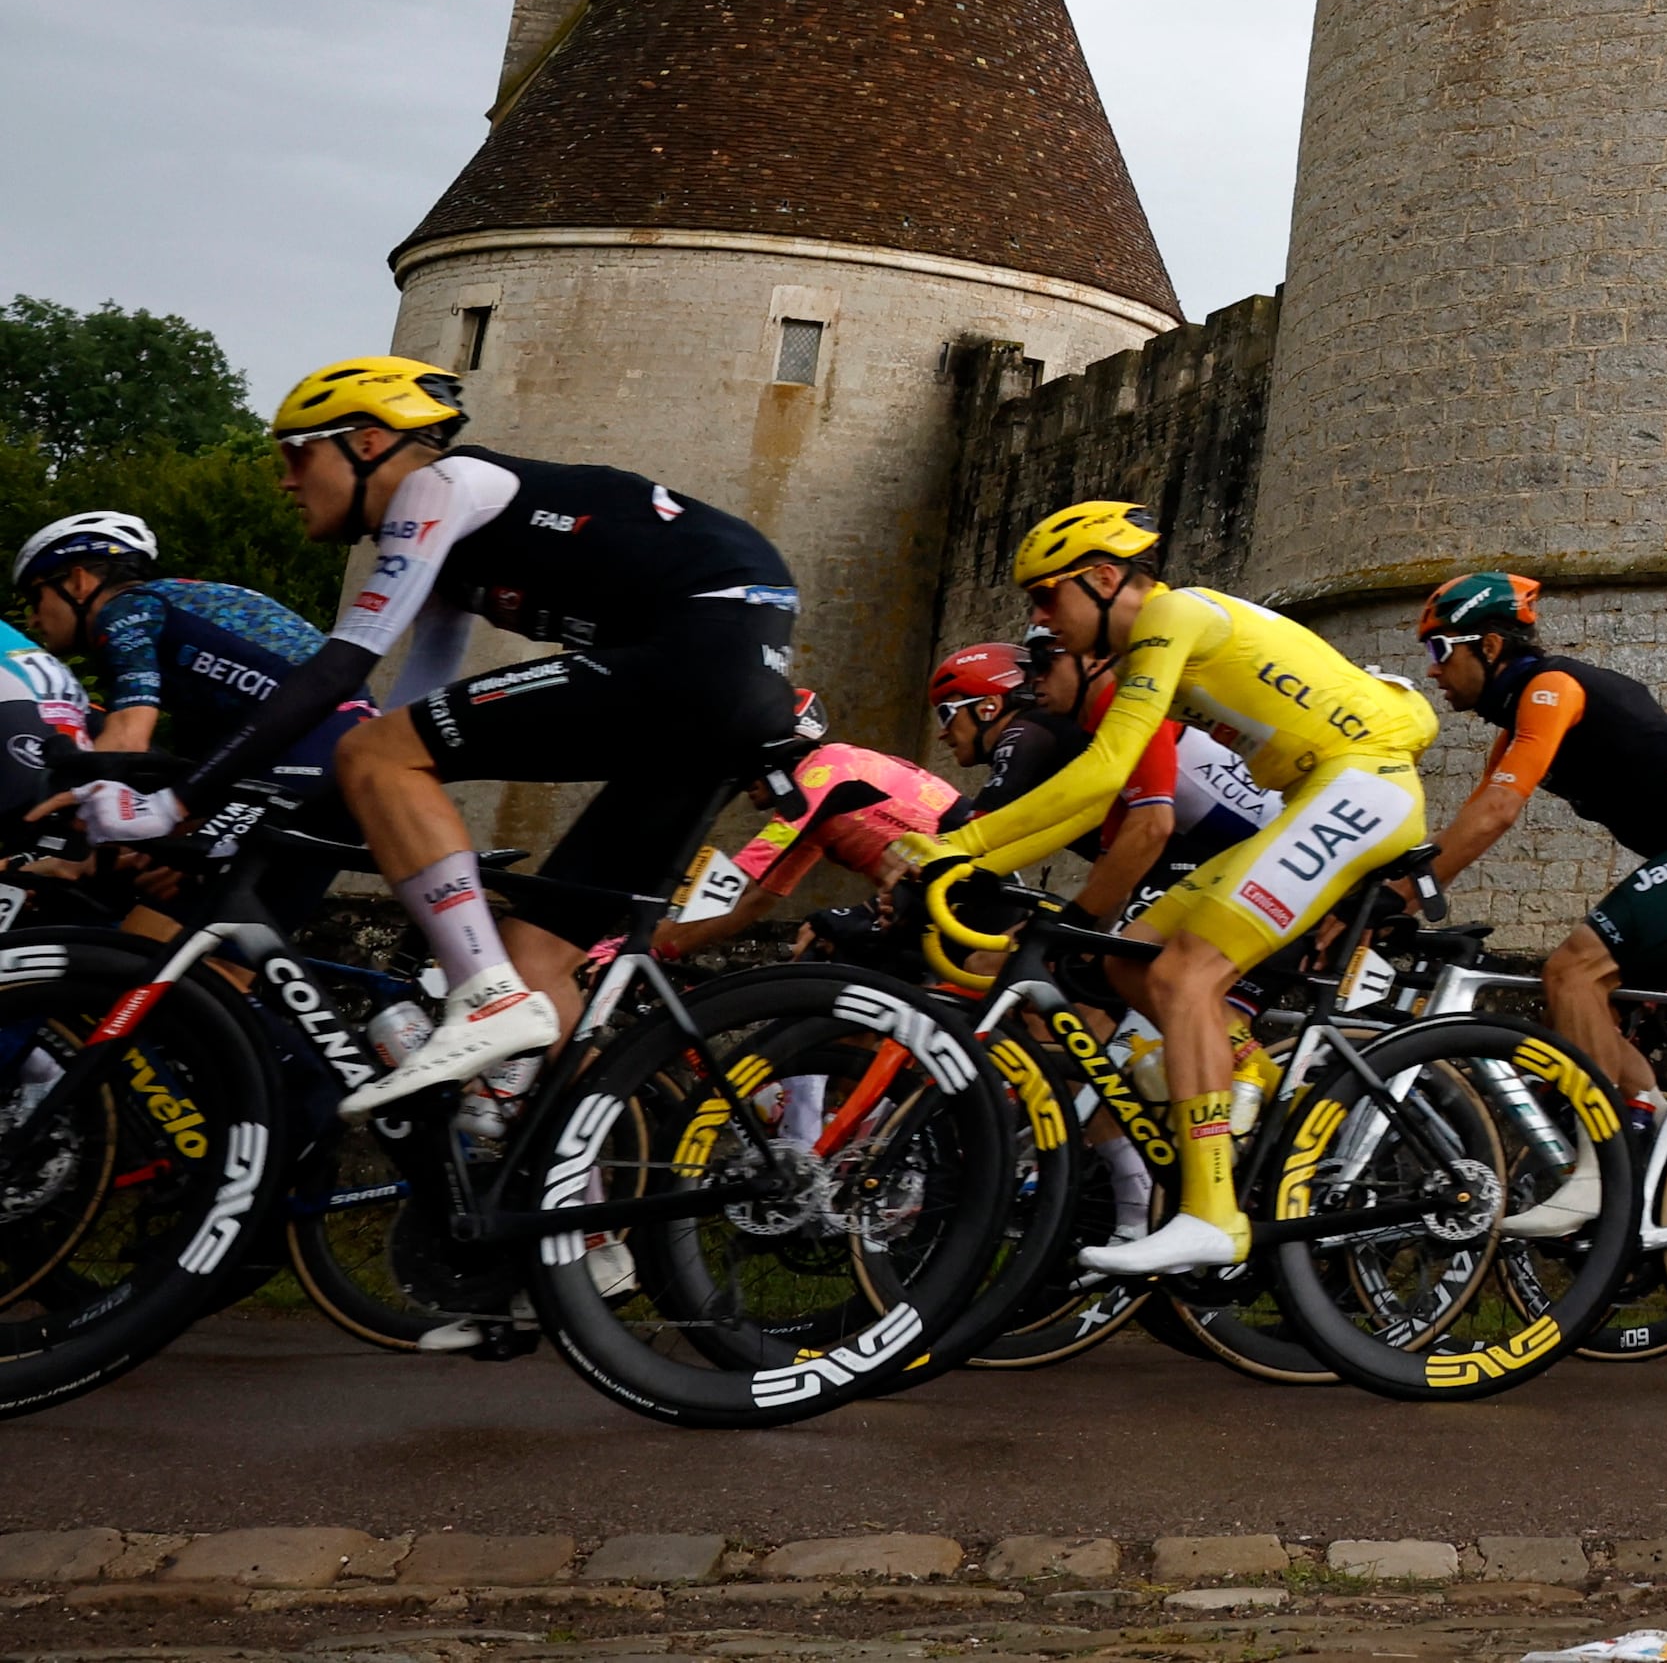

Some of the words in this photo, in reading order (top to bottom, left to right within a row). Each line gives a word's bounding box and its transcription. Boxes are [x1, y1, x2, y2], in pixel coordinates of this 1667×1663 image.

[529, 508, 578, 533] FAB
[1450, 586, 1493, 624] GIANT
[190, 650, 281, 702] BETCIT
[1257, 661, 1312, 711] LCL
[1194, 762, 1266, 819] ALULA
[1277, 798, 1382, 882] UAE
[425, 876, 473, 905] UAE
[702, 870, 741, 908] 15
[1245, 883, 1292, 928] Emirates
[1361, 969, 1392, 995] 11
[264, 956, 413, 1139] COLNAO
[121, 1046, 209, 1160] rvélo
[1052, 1011, 1177, 1166] COLNAGO
[329, 1184, 398, 1206] SRAM
